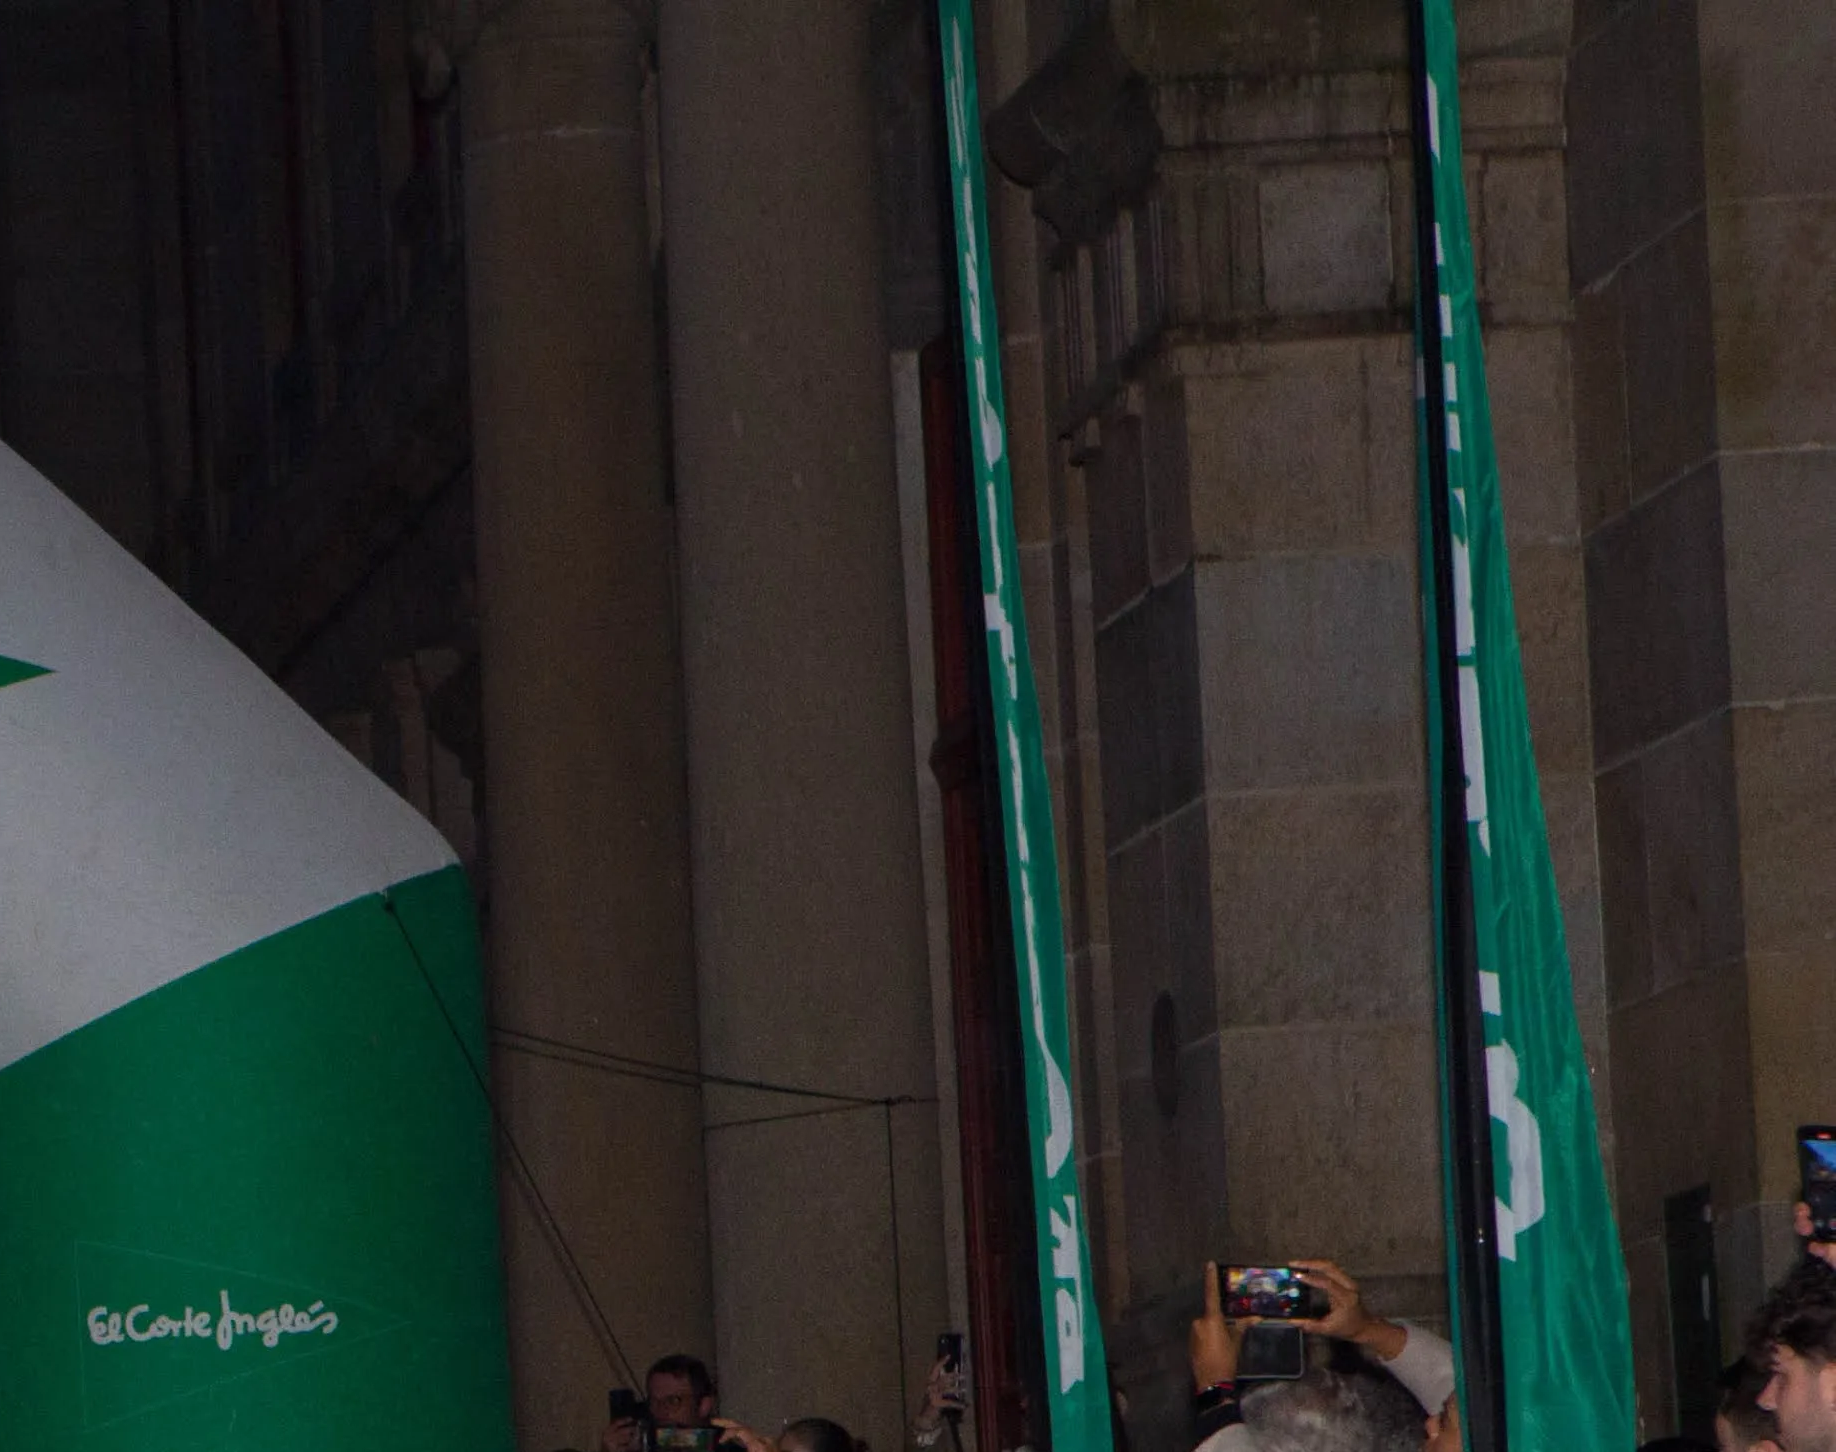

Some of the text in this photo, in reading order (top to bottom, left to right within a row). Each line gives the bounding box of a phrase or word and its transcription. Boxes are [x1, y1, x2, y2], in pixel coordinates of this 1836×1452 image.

[88, 1290, 339, 1349] El Corte Inglés
